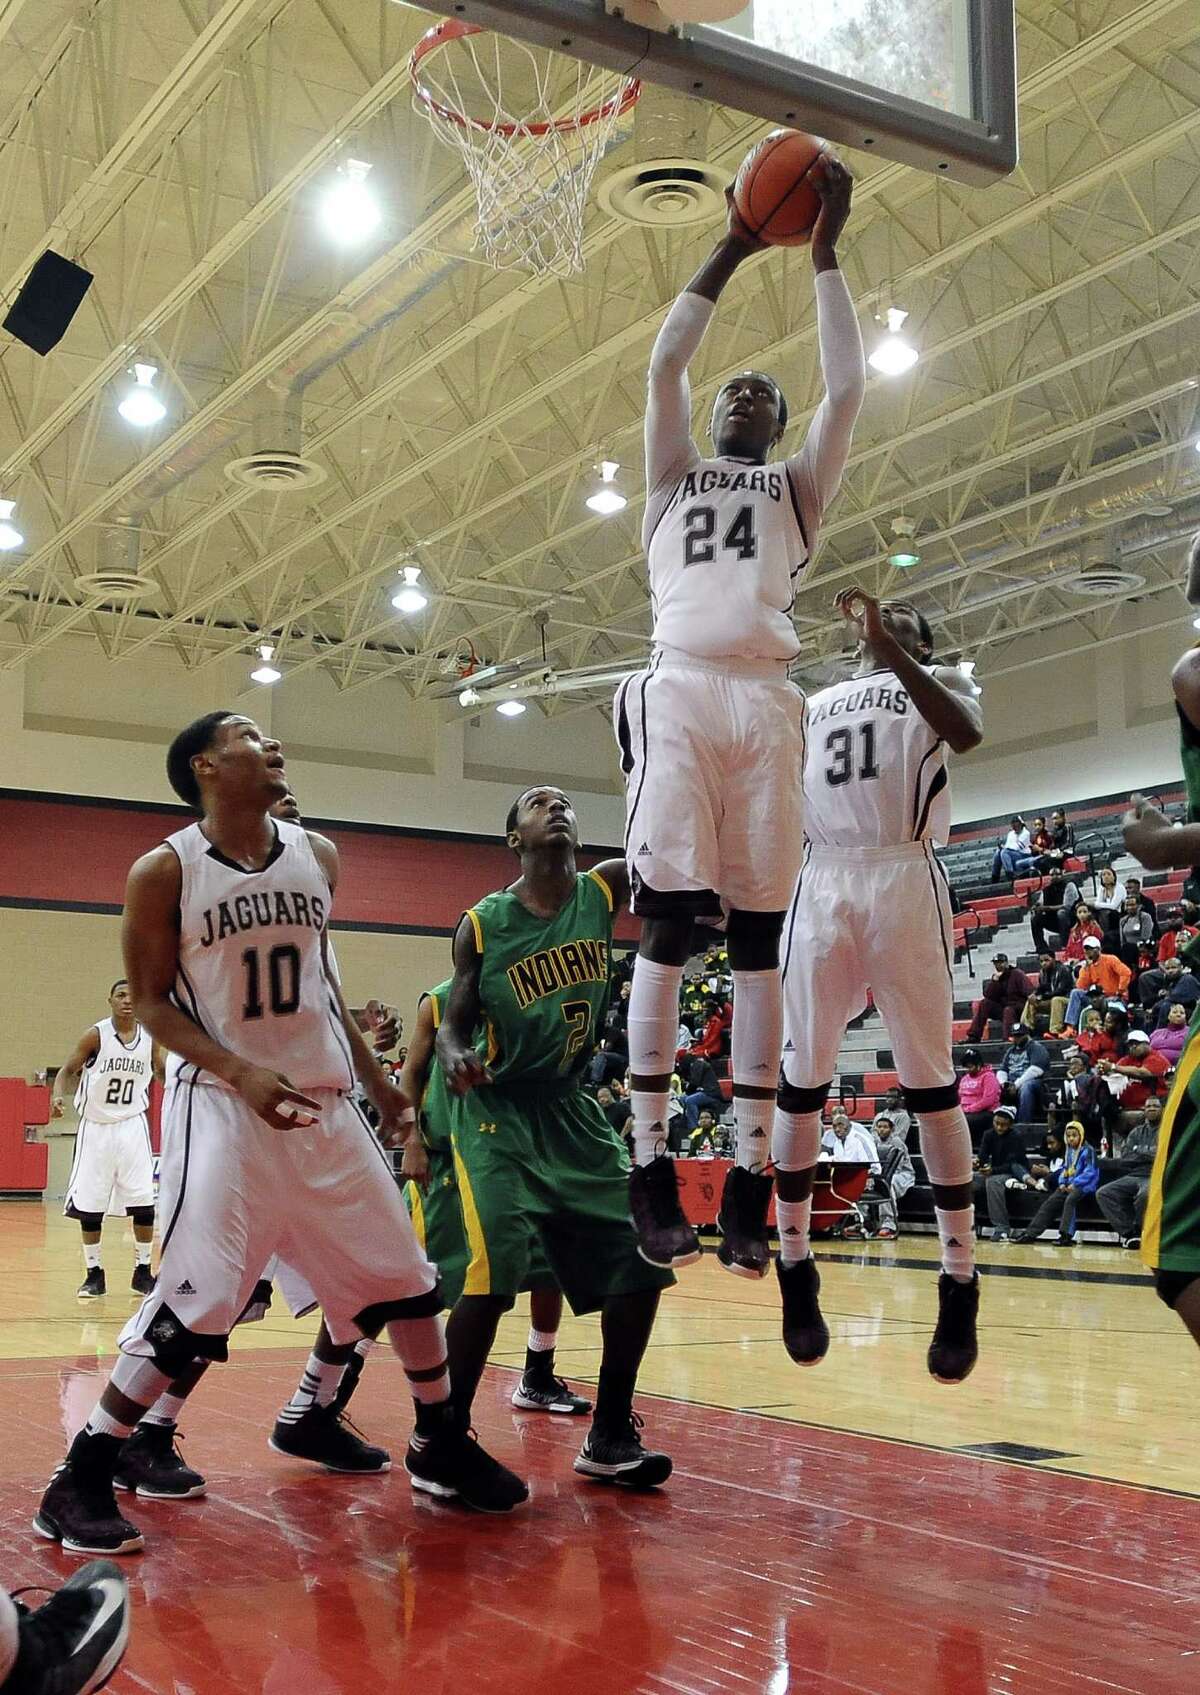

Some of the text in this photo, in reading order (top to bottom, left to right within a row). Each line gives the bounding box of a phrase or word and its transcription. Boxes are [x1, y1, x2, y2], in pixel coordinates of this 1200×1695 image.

[676, 469, 782, 503] AGUARS
[682, 504, 758, 568] 24
[824, 719, 880, 789] 31
[200, 891, 324, 947] JAGUARS
[241, 942, 300, 1021] 10
[100, 1057, 145, 1075] JAGUARS
[105, 1077, 134, 1105] 20
